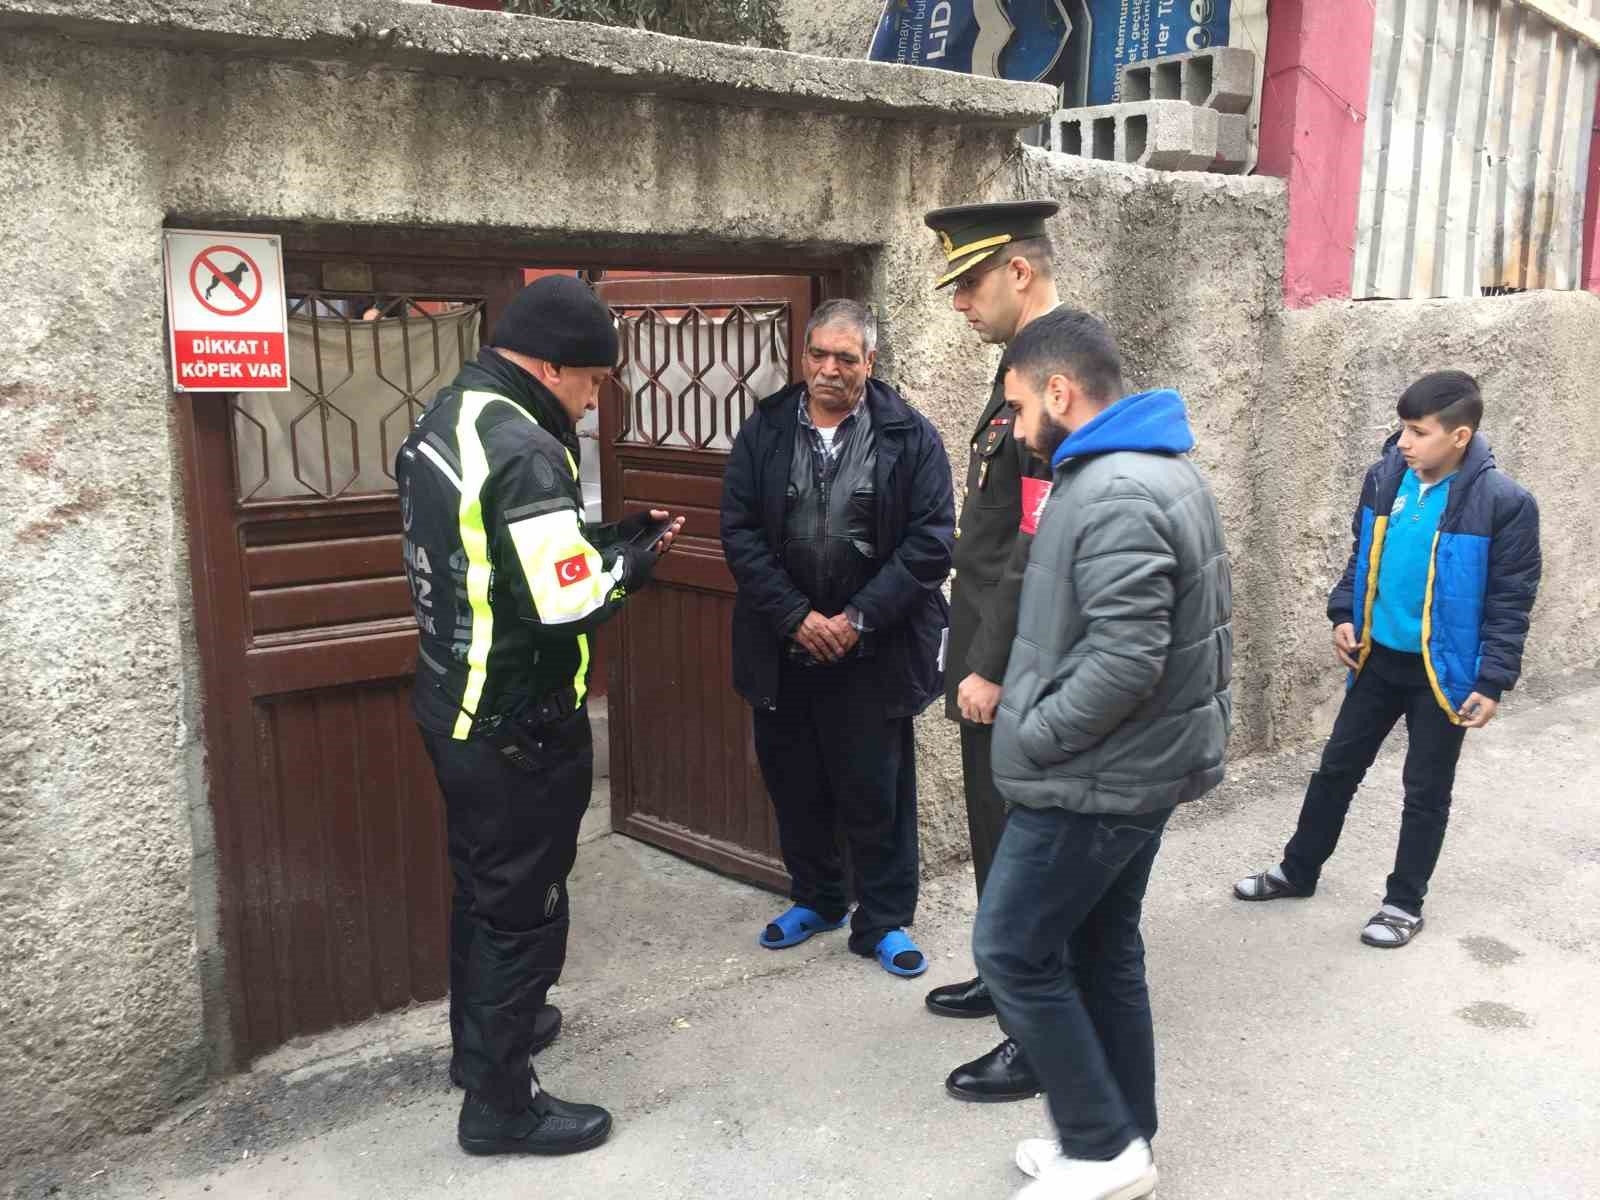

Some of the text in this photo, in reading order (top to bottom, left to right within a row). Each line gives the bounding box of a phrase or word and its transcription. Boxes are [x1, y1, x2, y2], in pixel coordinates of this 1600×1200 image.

[192, 336, 269, 355] DİKKAT !
[181, 360, 282, 378] KÖPEK VAR
